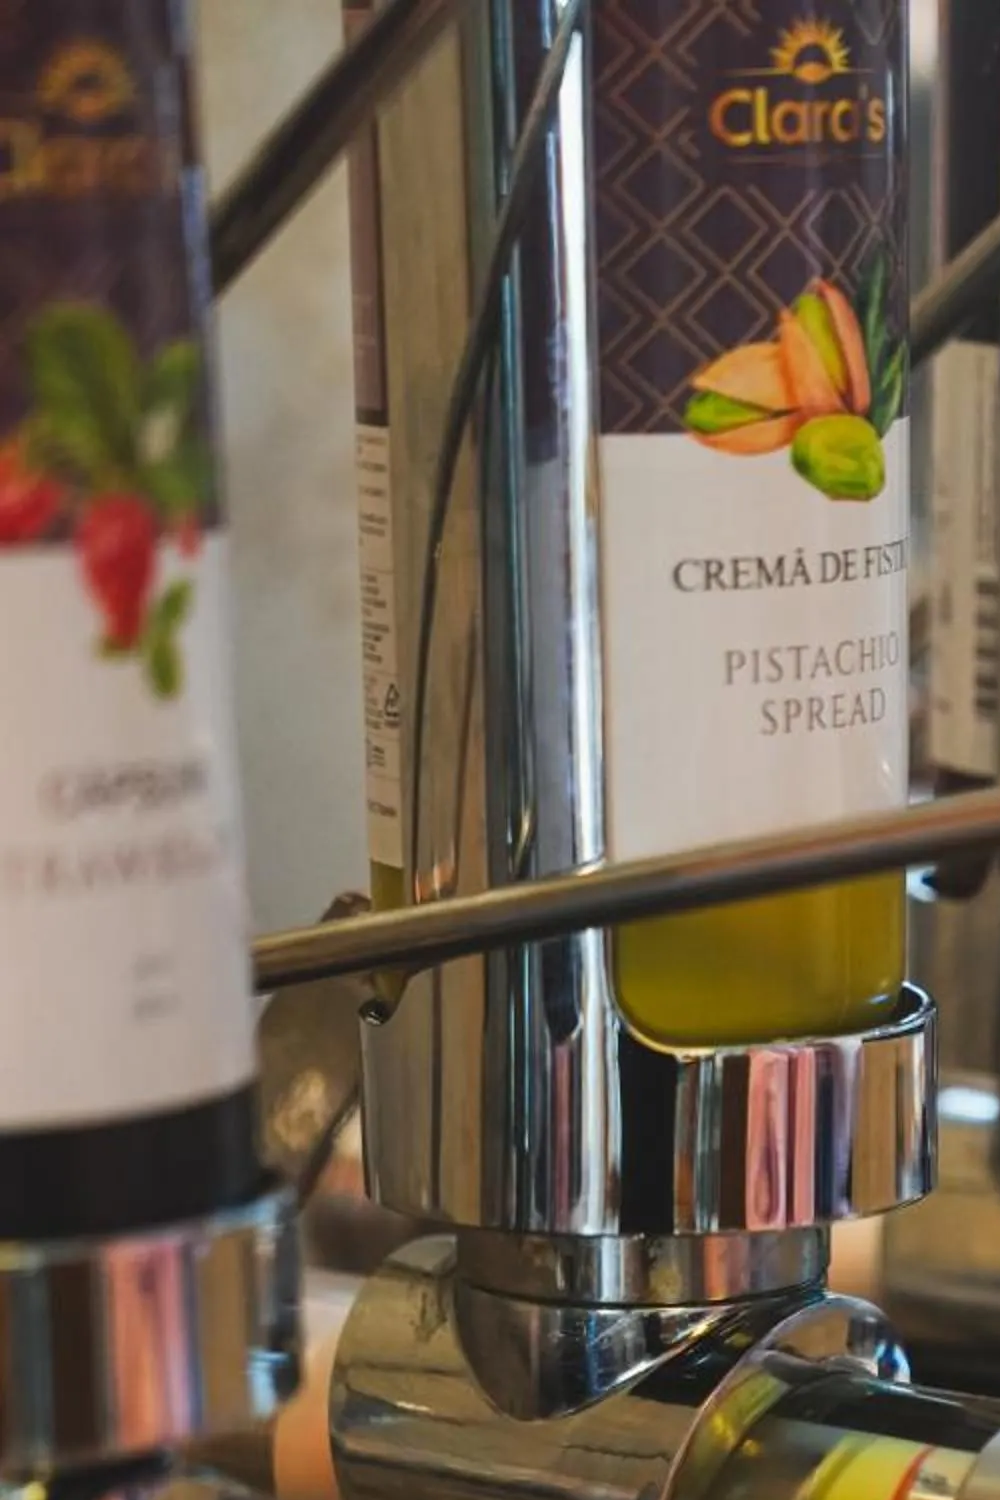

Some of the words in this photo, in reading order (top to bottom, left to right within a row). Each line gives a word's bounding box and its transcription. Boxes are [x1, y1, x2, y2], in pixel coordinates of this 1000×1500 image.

[709, 86, 886, 147] Clara's
[819, 549, 858, 584] DE
[723, 632, 900, 686] PISTACHIO
[761, 687, 886, 736] SPREAD
